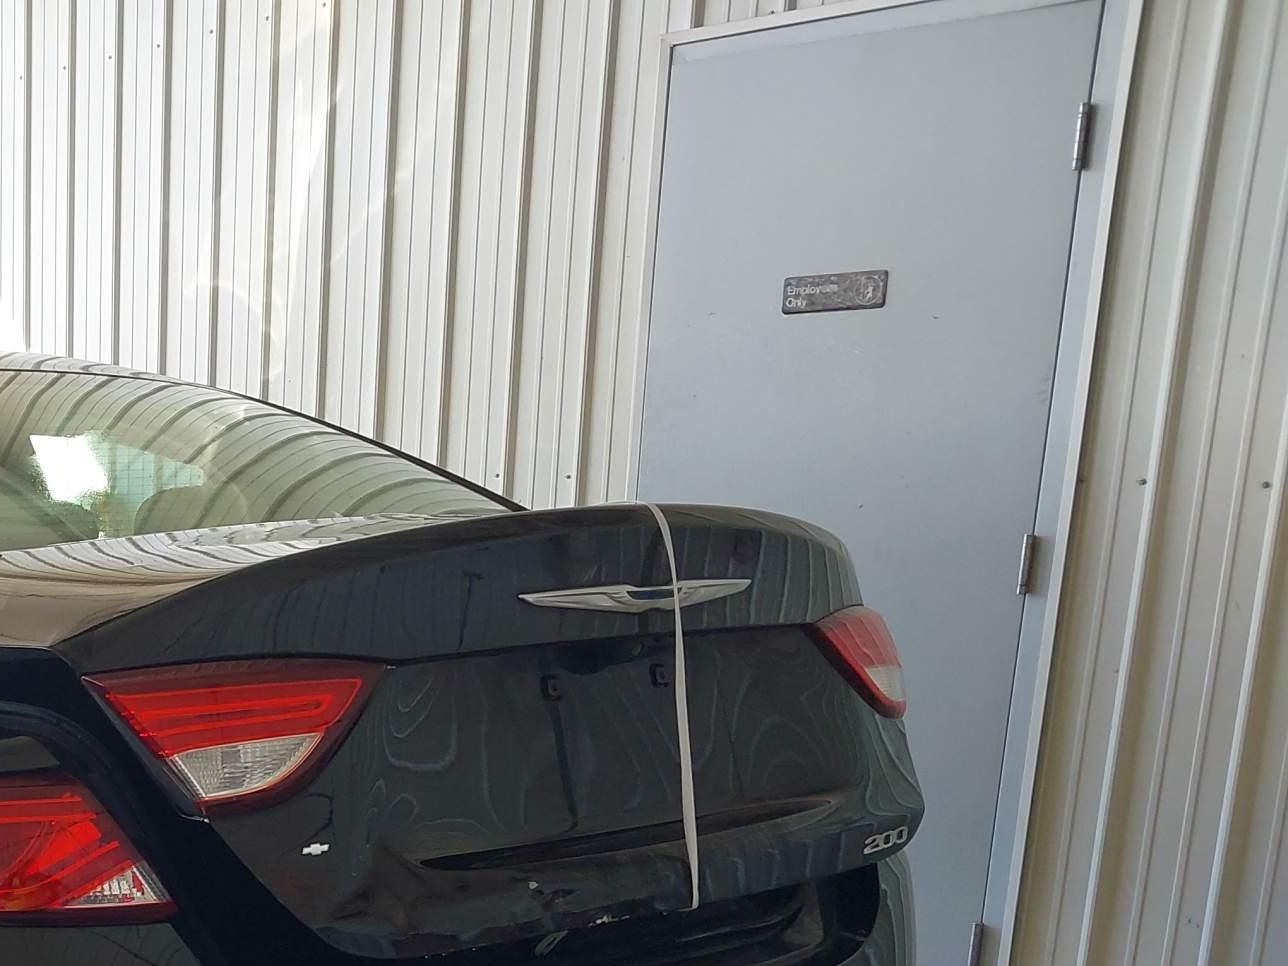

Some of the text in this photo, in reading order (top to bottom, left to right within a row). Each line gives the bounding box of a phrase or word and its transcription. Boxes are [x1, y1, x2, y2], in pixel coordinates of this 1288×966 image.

[787, 284, 838, 296] Employe
[786, 297, 807, 309] Only
[863, 826, 909, 855] 200
